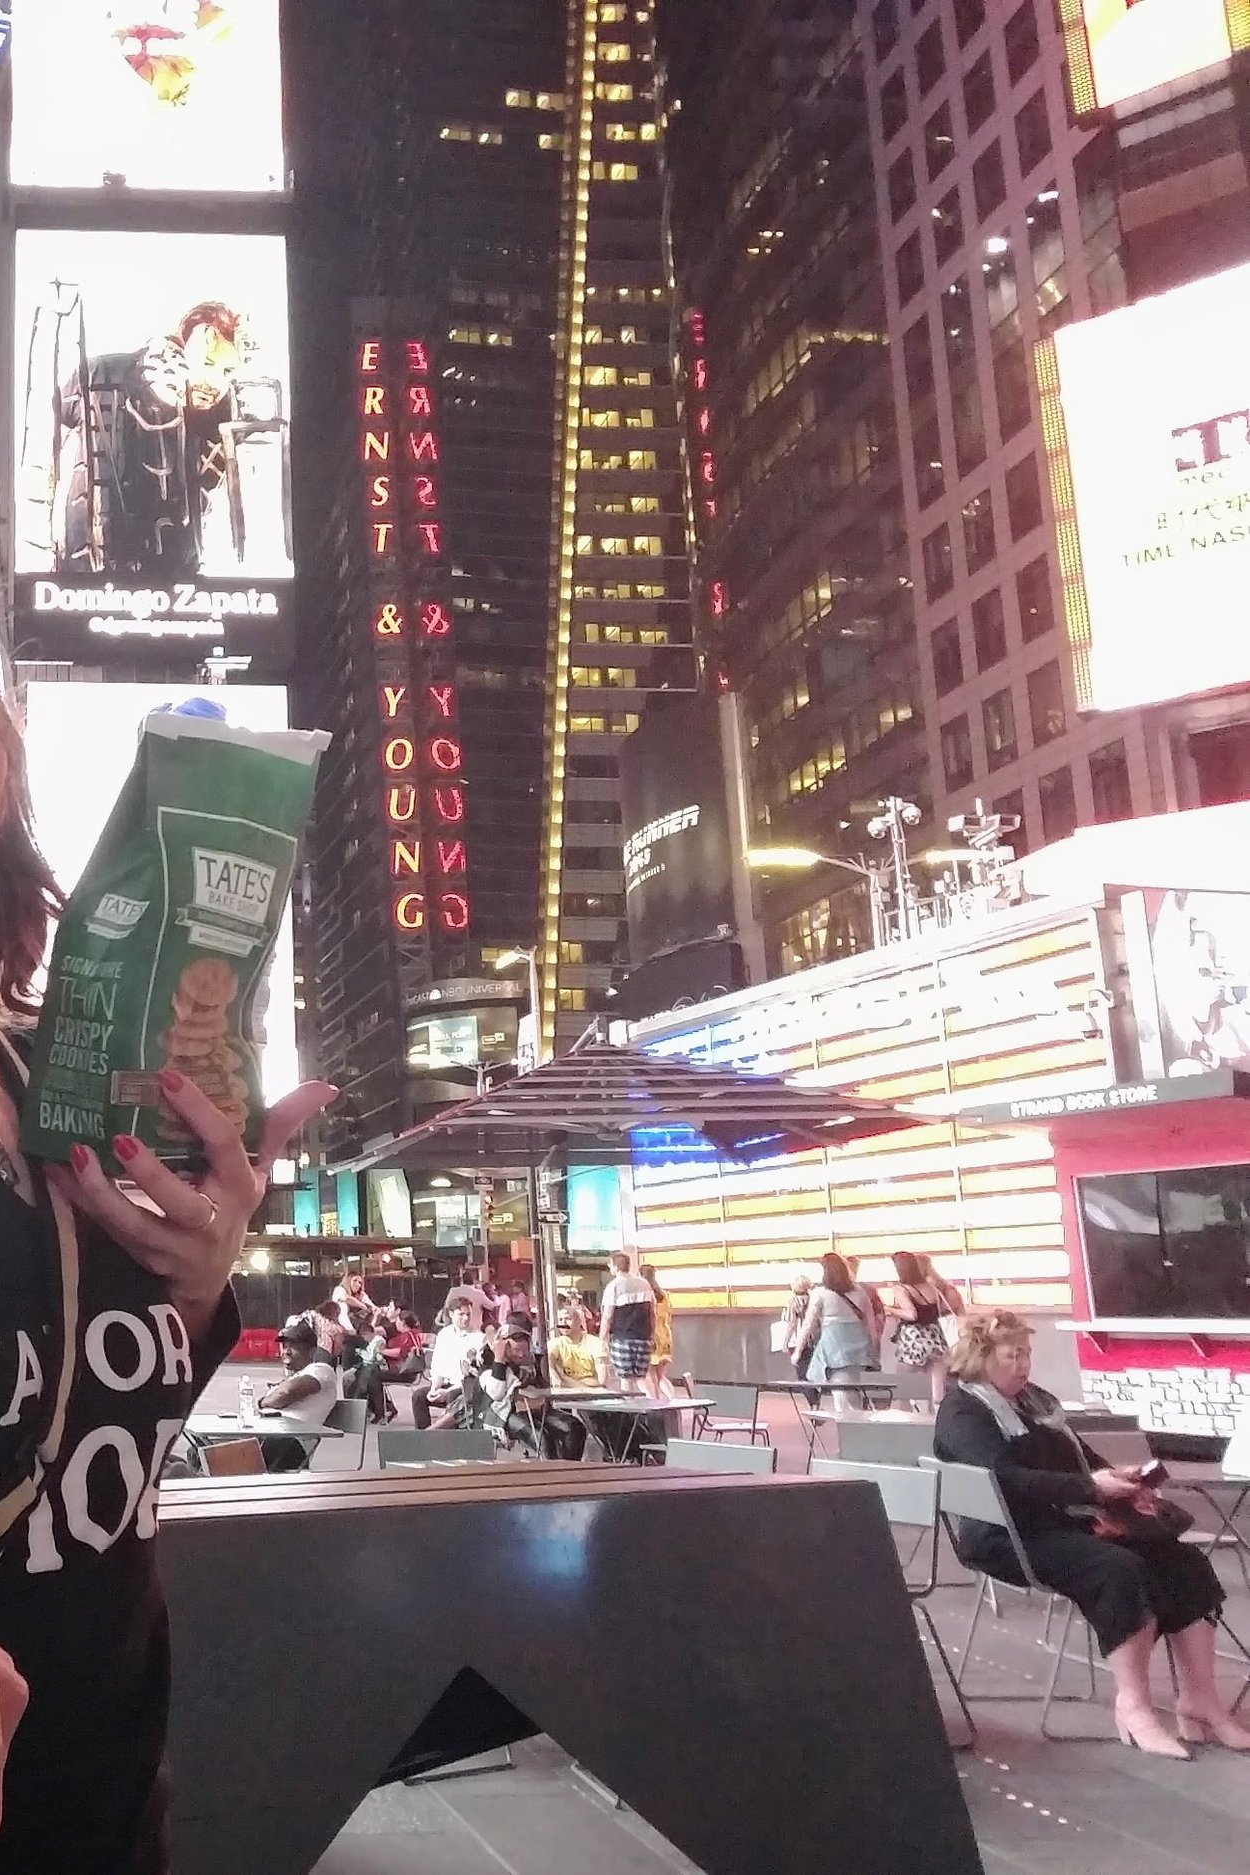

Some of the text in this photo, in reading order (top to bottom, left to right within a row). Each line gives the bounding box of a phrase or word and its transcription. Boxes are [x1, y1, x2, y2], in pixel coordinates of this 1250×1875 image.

[34, 580, 279, 619] Domingo Zapata
[361, 342, 425, 929] ERNST & YOUNG
[39, 1101, 106, 1141] BAKING
[1010, 1084, 1159, 1119] STRAND BOOK STORE
